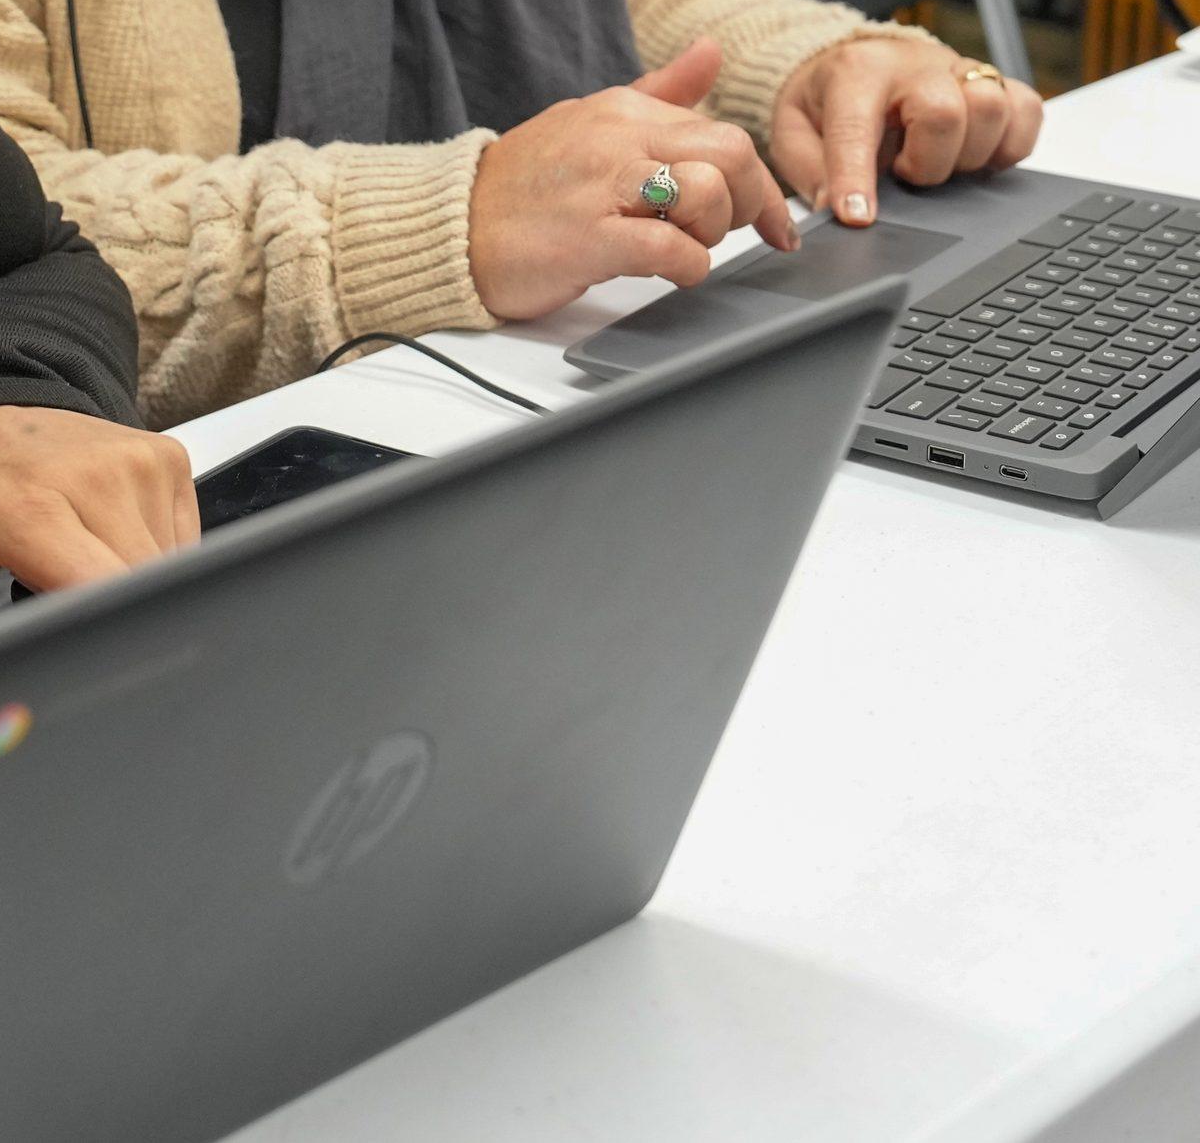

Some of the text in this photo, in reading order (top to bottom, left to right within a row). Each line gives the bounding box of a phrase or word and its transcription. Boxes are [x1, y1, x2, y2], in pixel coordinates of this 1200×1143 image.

[1143, 244, 1158, 253] s
[1123, 258, 1138, 267] d
[1175, 263, 1190, 271] e
[1046, 269, 1061, 277] v
[1157, 277, 1170, 285] r
[1024, 282, 1043, 290] b
[1078, 284, 1097, 293] g
[1002, 296, 1017, 304] n
[1060, 298, 1080, 307] h
[1112, 304, 1129, 313] y
[978, 310, 996, 320] m
[1036, 312, 1057, 321] j
[1093, 319, 1108, 328] u
[1050, 348, 1064, 358] o
[1024, 364, 1042, 374] p
[1080, 365, 1094, 374] 0
[907, 400, 924, 411] enter
[1007, 416, 1037, 434] backspace
[285, 731, 432, 884] hp
